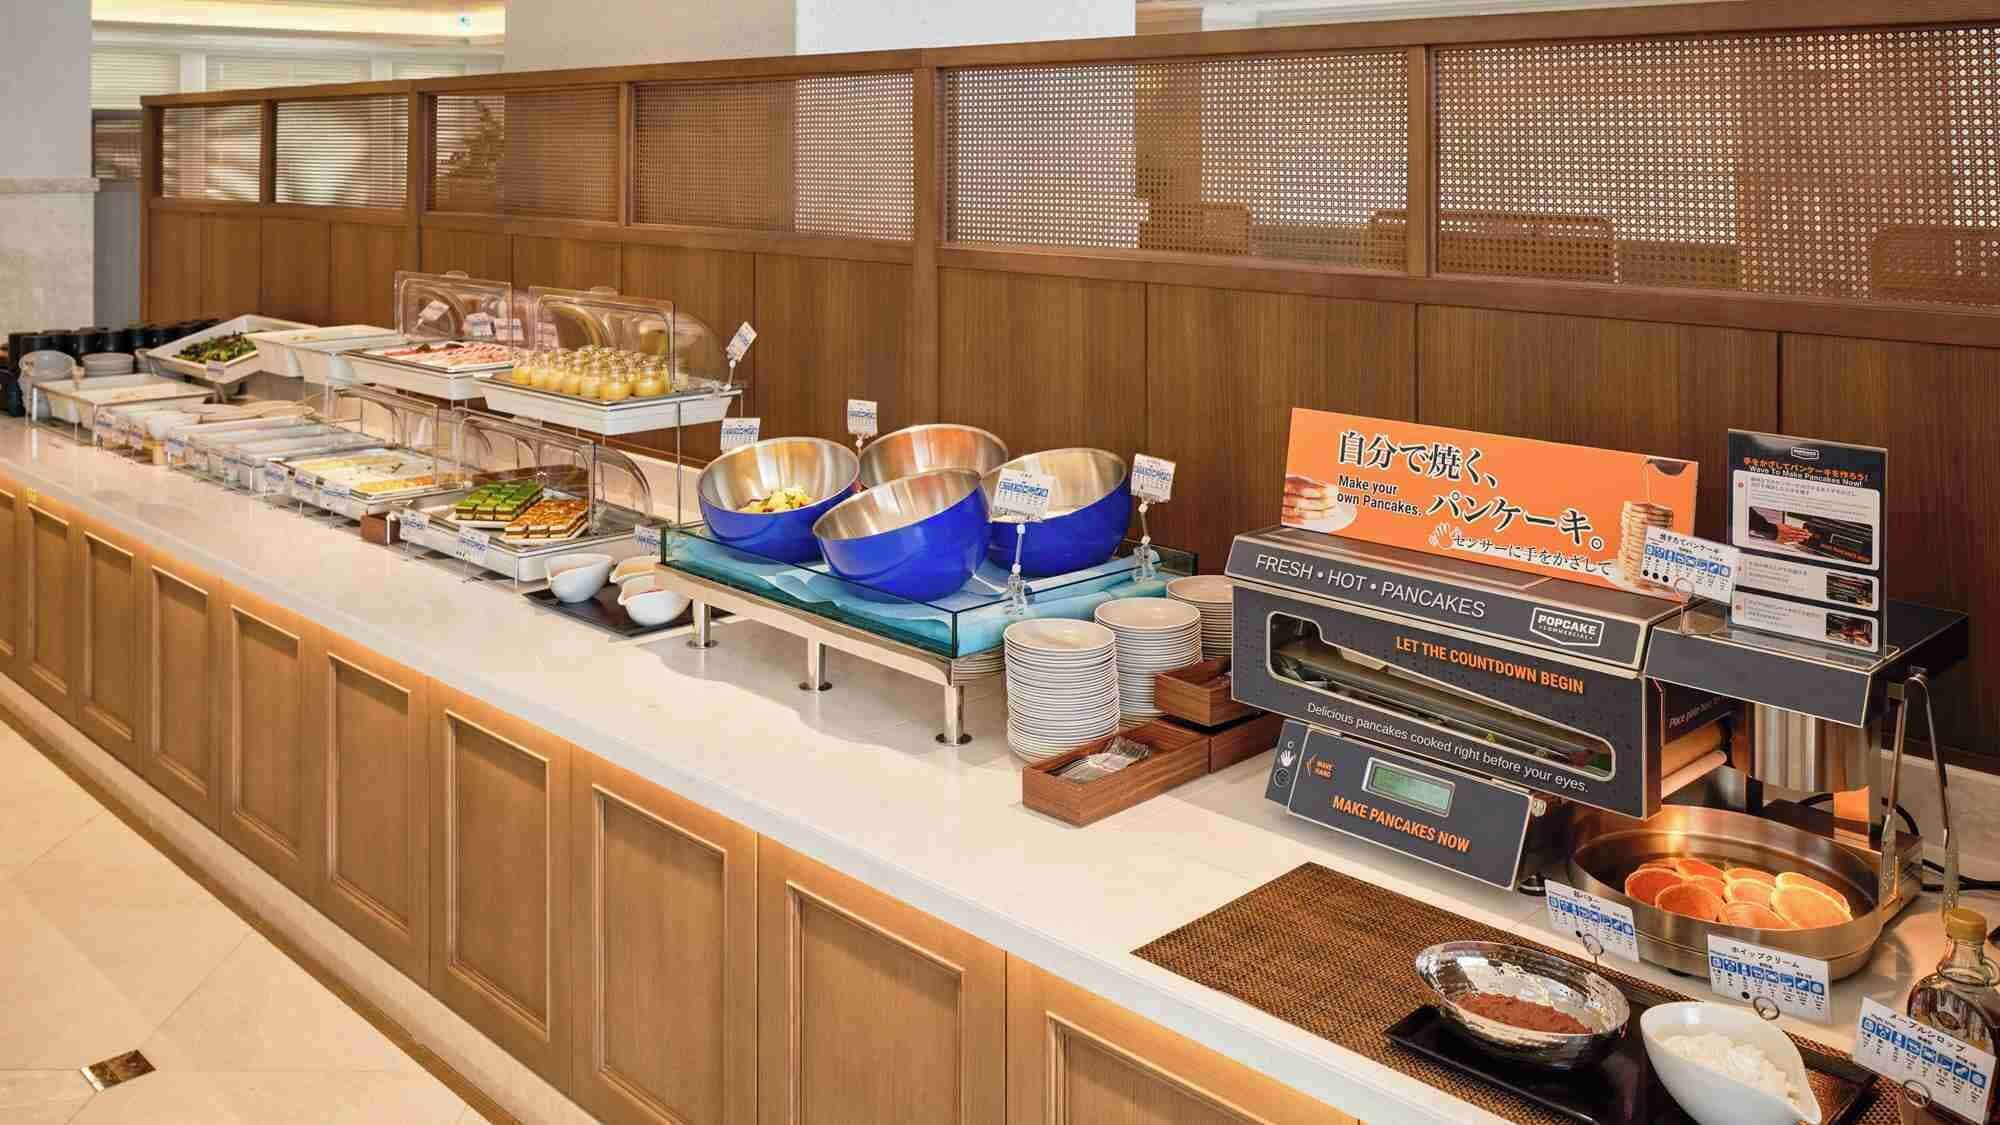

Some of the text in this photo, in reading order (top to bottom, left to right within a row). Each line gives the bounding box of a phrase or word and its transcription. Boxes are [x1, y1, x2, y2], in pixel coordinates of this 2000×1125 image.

[1338, 430, 1499, 488] 自分で焼く、
[1338, 475, 1398, 496] Make your
[1336, 491, 1424, 517] own Pancakes.
[1427, 490, 1603, 550] パンケーキ。
[1255, 553, 1486, 618] FRESH HOT PANCAKES
[1537, 614, 1597, 636] POPCAKE
[1396, 636, 1584, 694] LET THE COUNTDOWN BEGIN
[1308, 702, 1589, 793] Delicious pancakes cooked right before your eyes.
[1332, 795, 1471, 853] MAKE PANCAKES NOW
